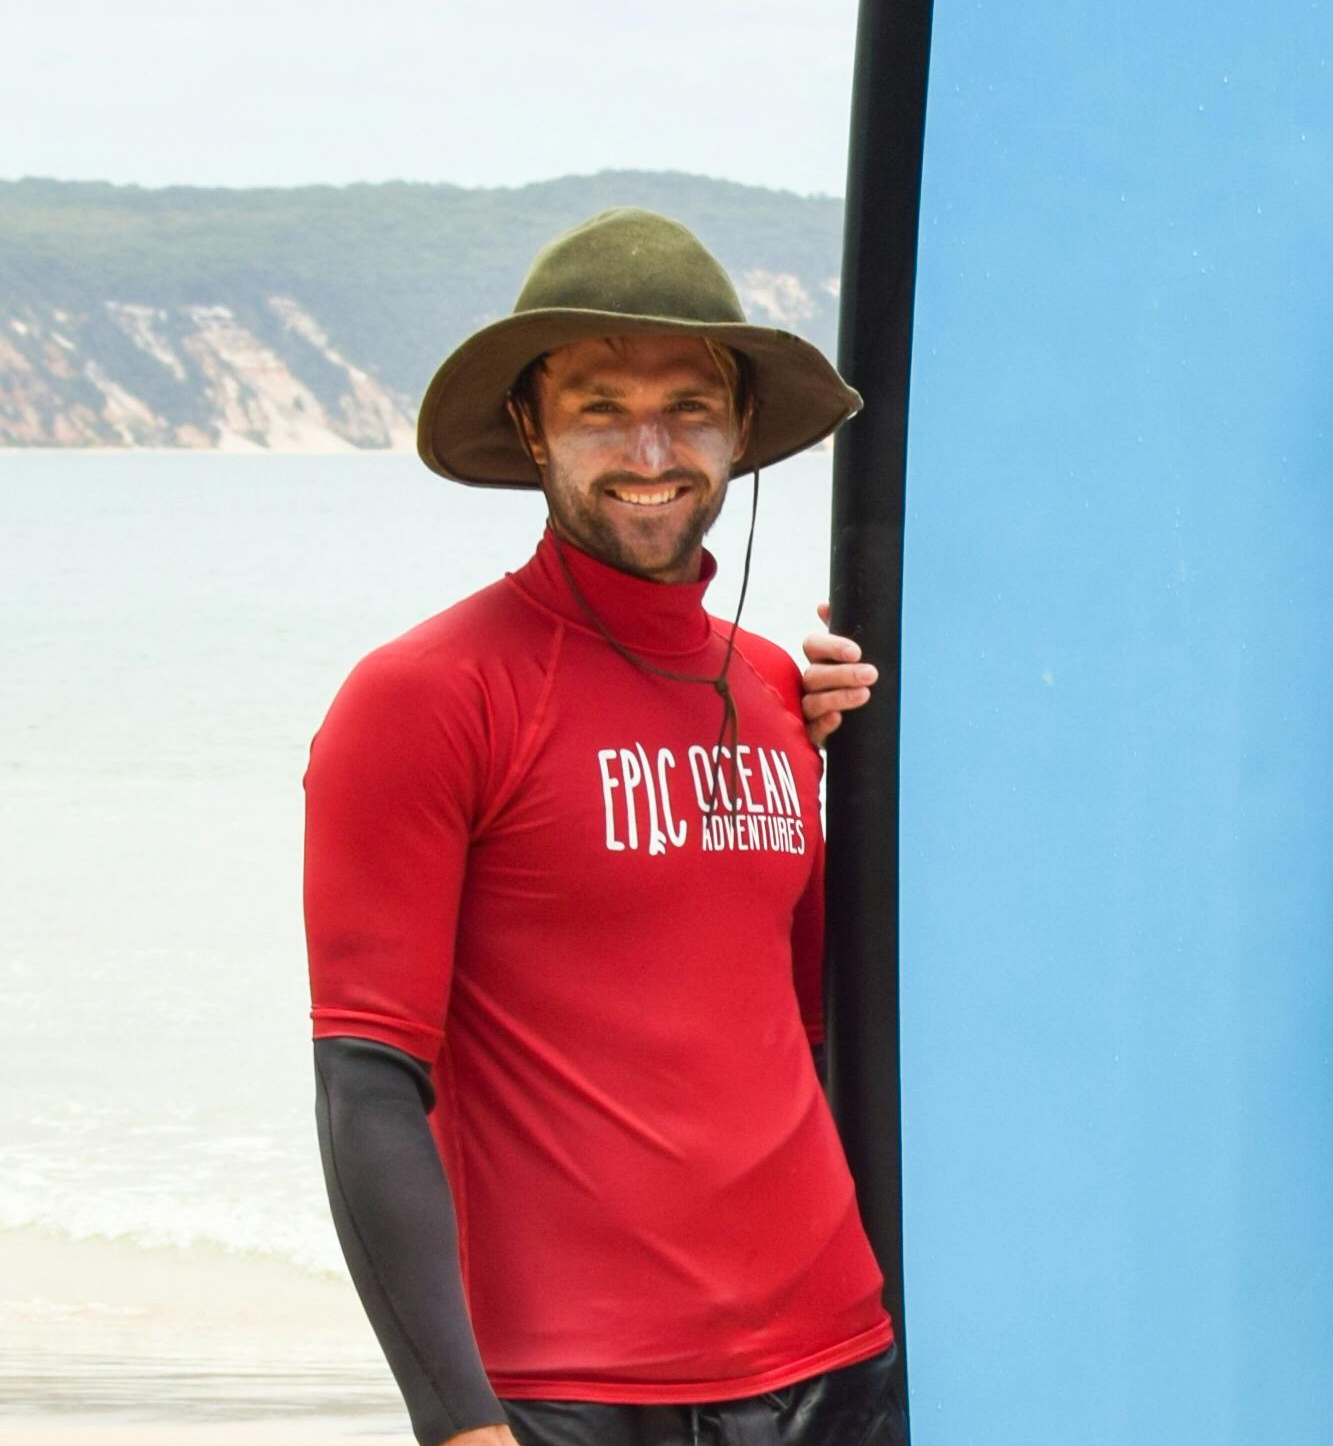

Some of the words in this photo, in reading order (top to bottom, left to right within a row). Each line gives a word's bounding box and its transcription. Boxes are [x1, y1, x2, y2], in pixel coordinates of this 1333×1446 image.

[598, 741, 688, 856] EPIC
[688, 744, 803, 818] OCEAN
[702, 814, 805, 856] ADVENTURES
